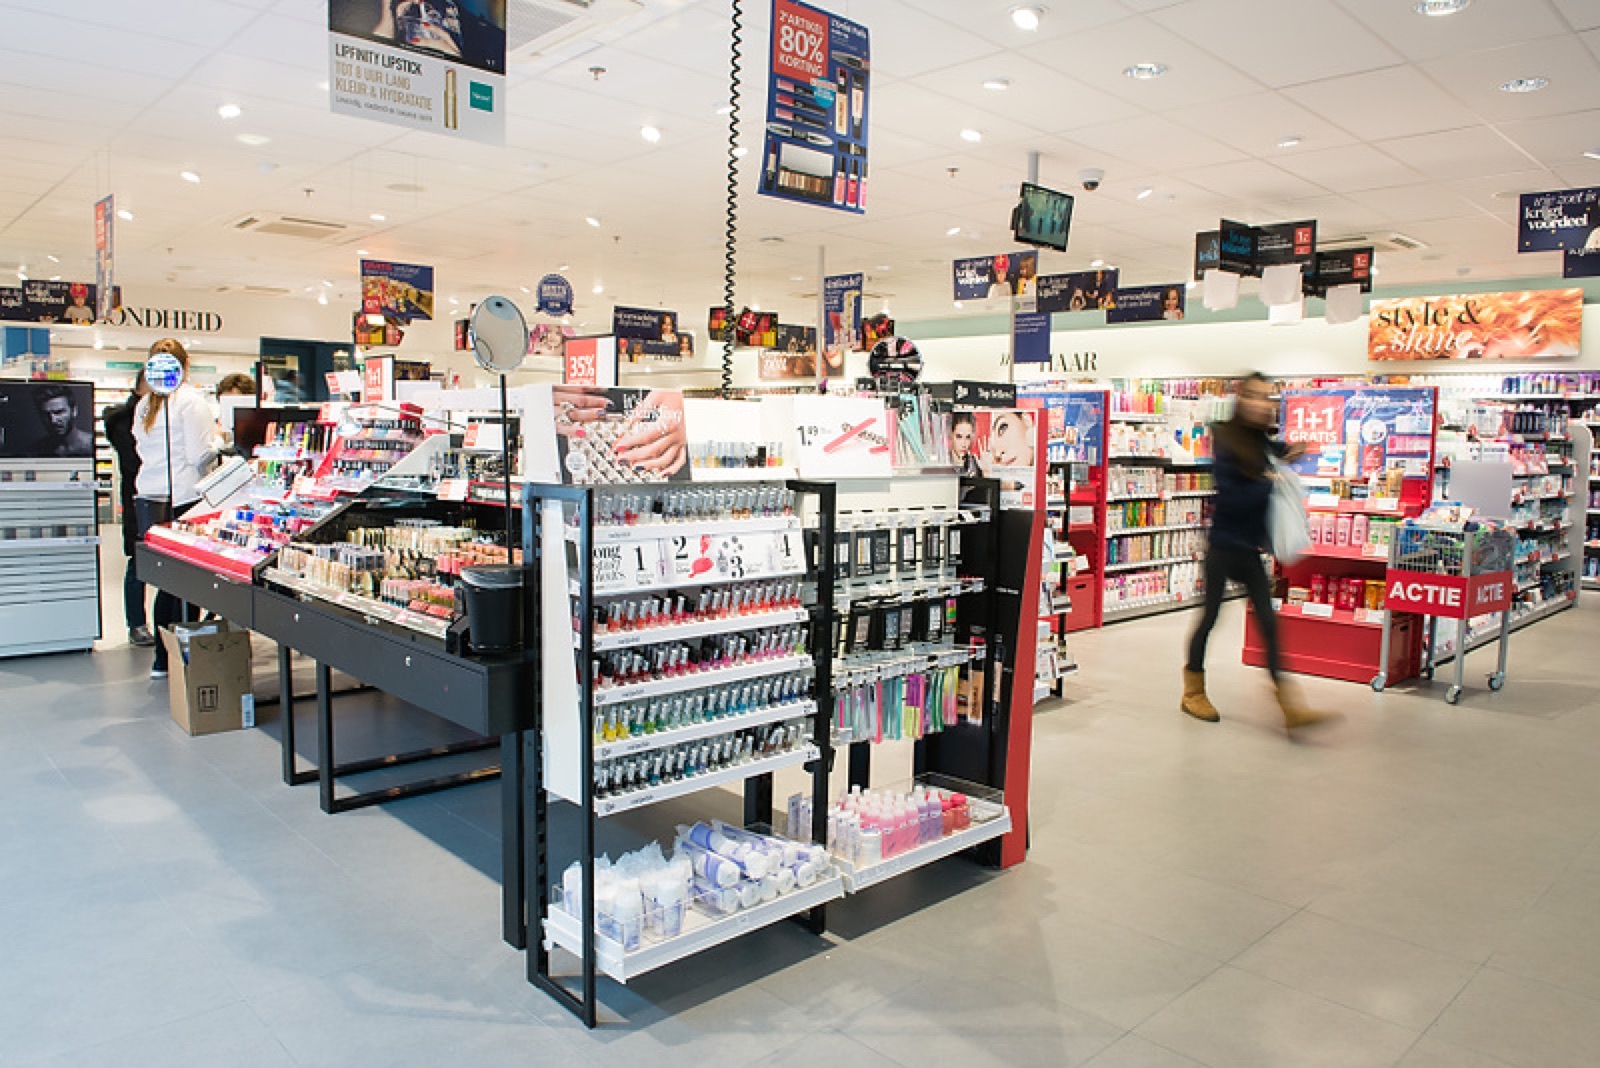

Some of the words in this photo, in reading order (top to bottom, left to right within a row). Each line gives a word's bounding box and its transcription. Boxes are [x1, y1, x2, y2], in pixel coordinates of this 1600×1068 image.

[780, 25, 824, 62] 80%
[335, 43, 380, 68] LIPFINITY
[382, 54, 422, 75] LIPSTICK
[779, 52, 822, 76] KORTING
[336, 61, 352, 76] TOT
[386, 73, 411, 90] LANG
[336, 77, 367, 94] KLEUR
[104, 306, 223, 331] ONDHEID
[1377, 301, 1448, 333] style
[1457, 300, 1480, 325] &
[1390, 324, 1472, 352] shine
[569, 353, 595, 377] 35%
[1292, 407, 1336, 430] 1+1
[1289, 430, 1338, 443] GRATIS
[634, 545, 645, 571] 1
[672, 535, 689, 560] 2
[729, 555, 745, 579] 3
[1389, 581, 1462, 607] ACTIE
[1476, 583, 1503, 604] ACTIE
